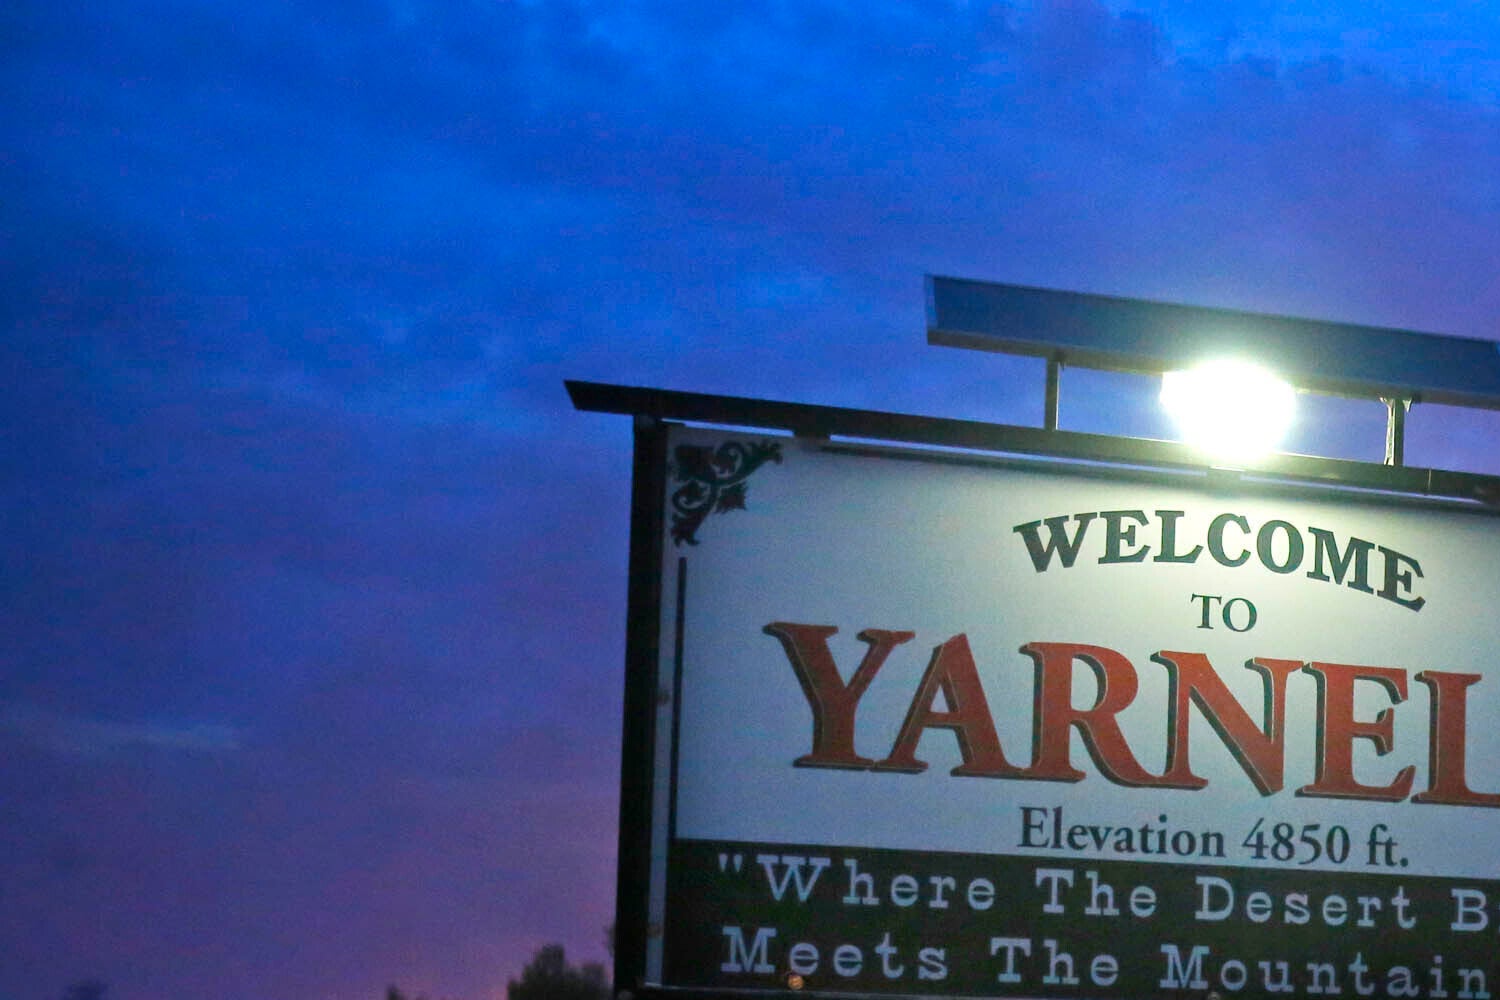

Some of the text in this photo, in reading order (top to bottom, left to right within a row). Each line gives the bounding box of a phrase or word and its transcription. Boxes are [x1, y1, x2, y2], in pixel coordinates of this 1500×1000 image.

[1013, 509, 1426, 612] WELCOME
[1191, 593, 1258, 632] TO
[1017, 806, 1409, 867] Elevation 4850 ft.
[718, 853, 996, 910] "Where
[1035, 868, 1157, 918] The
[1195, 876, 1417, 929] Desert
[720, 925, 949, 980] Meets
[990, 937, 1120, 986] The
[1160, 944, 1492, 1000] Mountain
